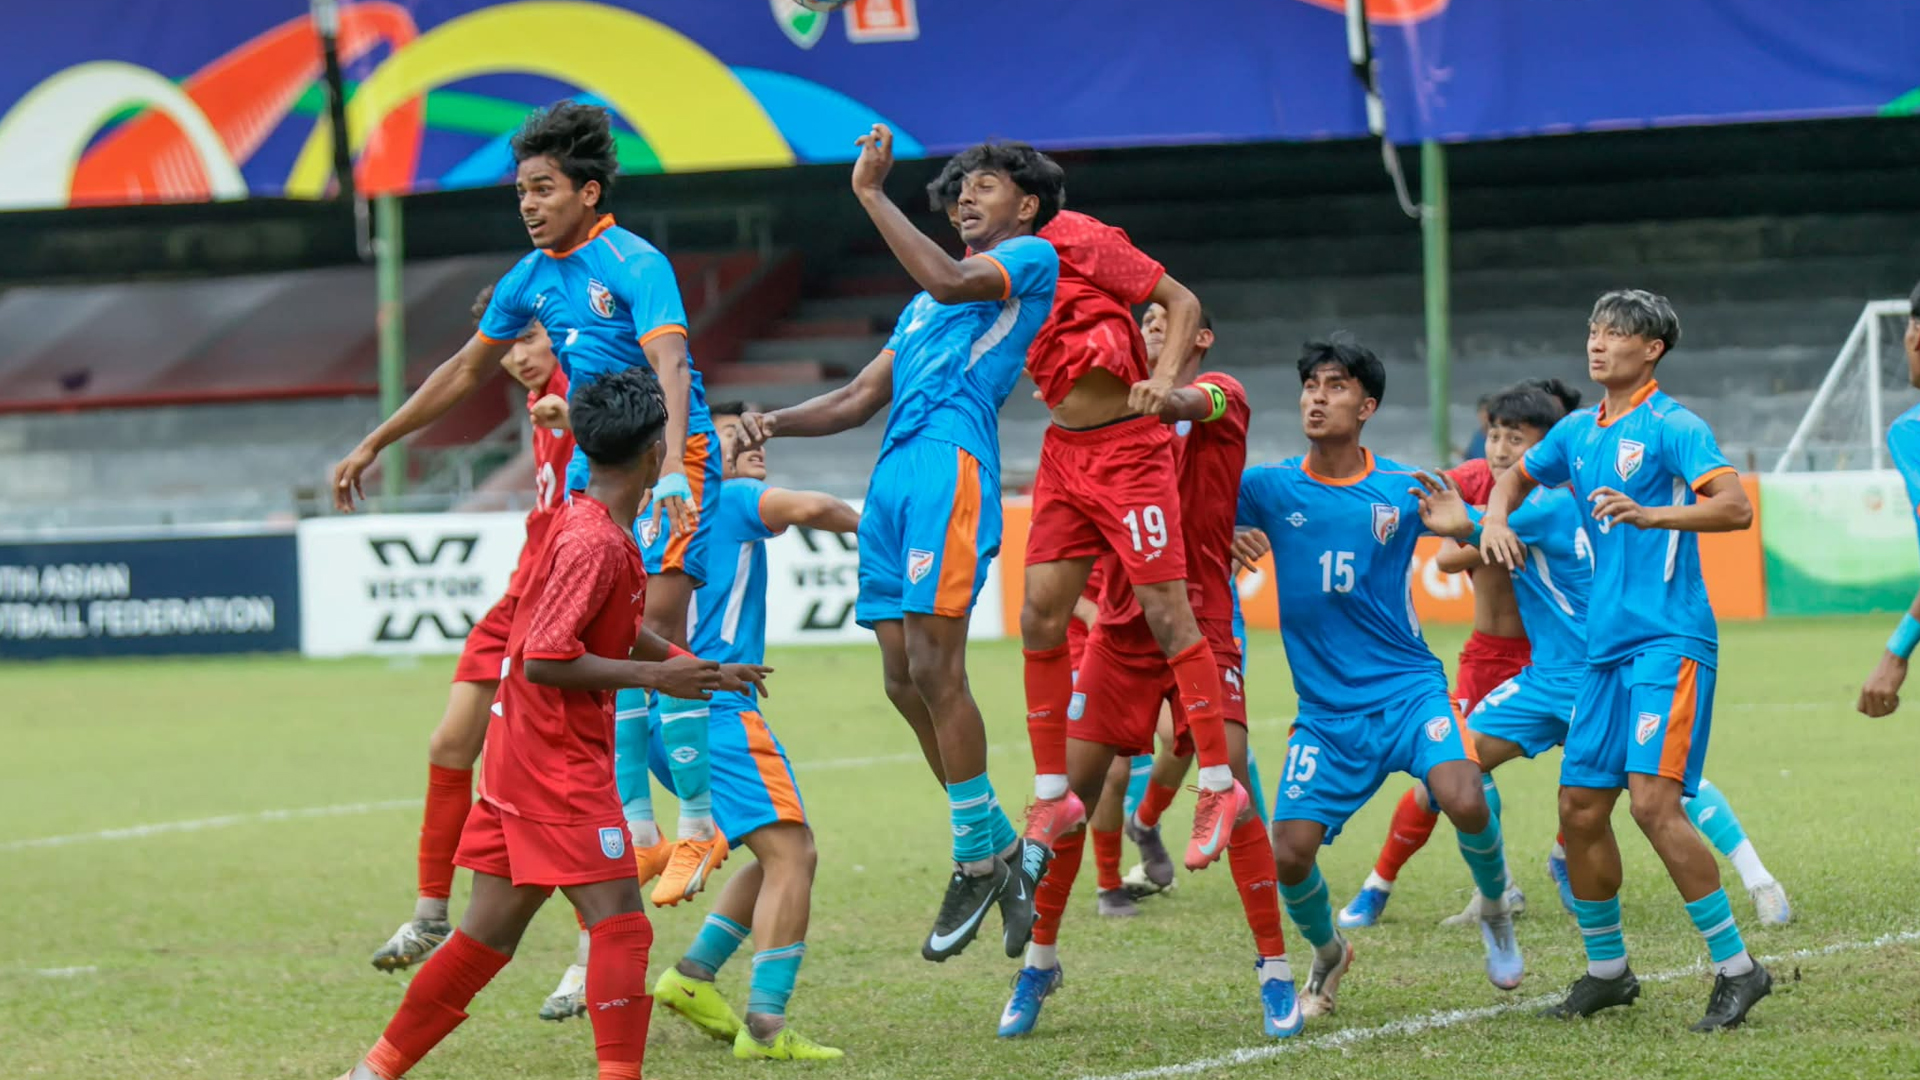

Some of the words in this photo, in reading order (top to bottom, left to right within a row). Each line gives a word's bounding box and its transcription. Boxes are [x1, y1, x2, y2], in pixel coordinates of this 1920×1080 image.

[1123, 504, 1168, 551] 19
[41, 562, 131, 599] ASIAN
[365, 576, 483, 600] VECTOR
[790, 563, 860, 588] VEC
[1319, 550, 1355, 593] 15
[88, 596, 275, 637] FEDERATION
[1286, 744, 1320, 782] 15
